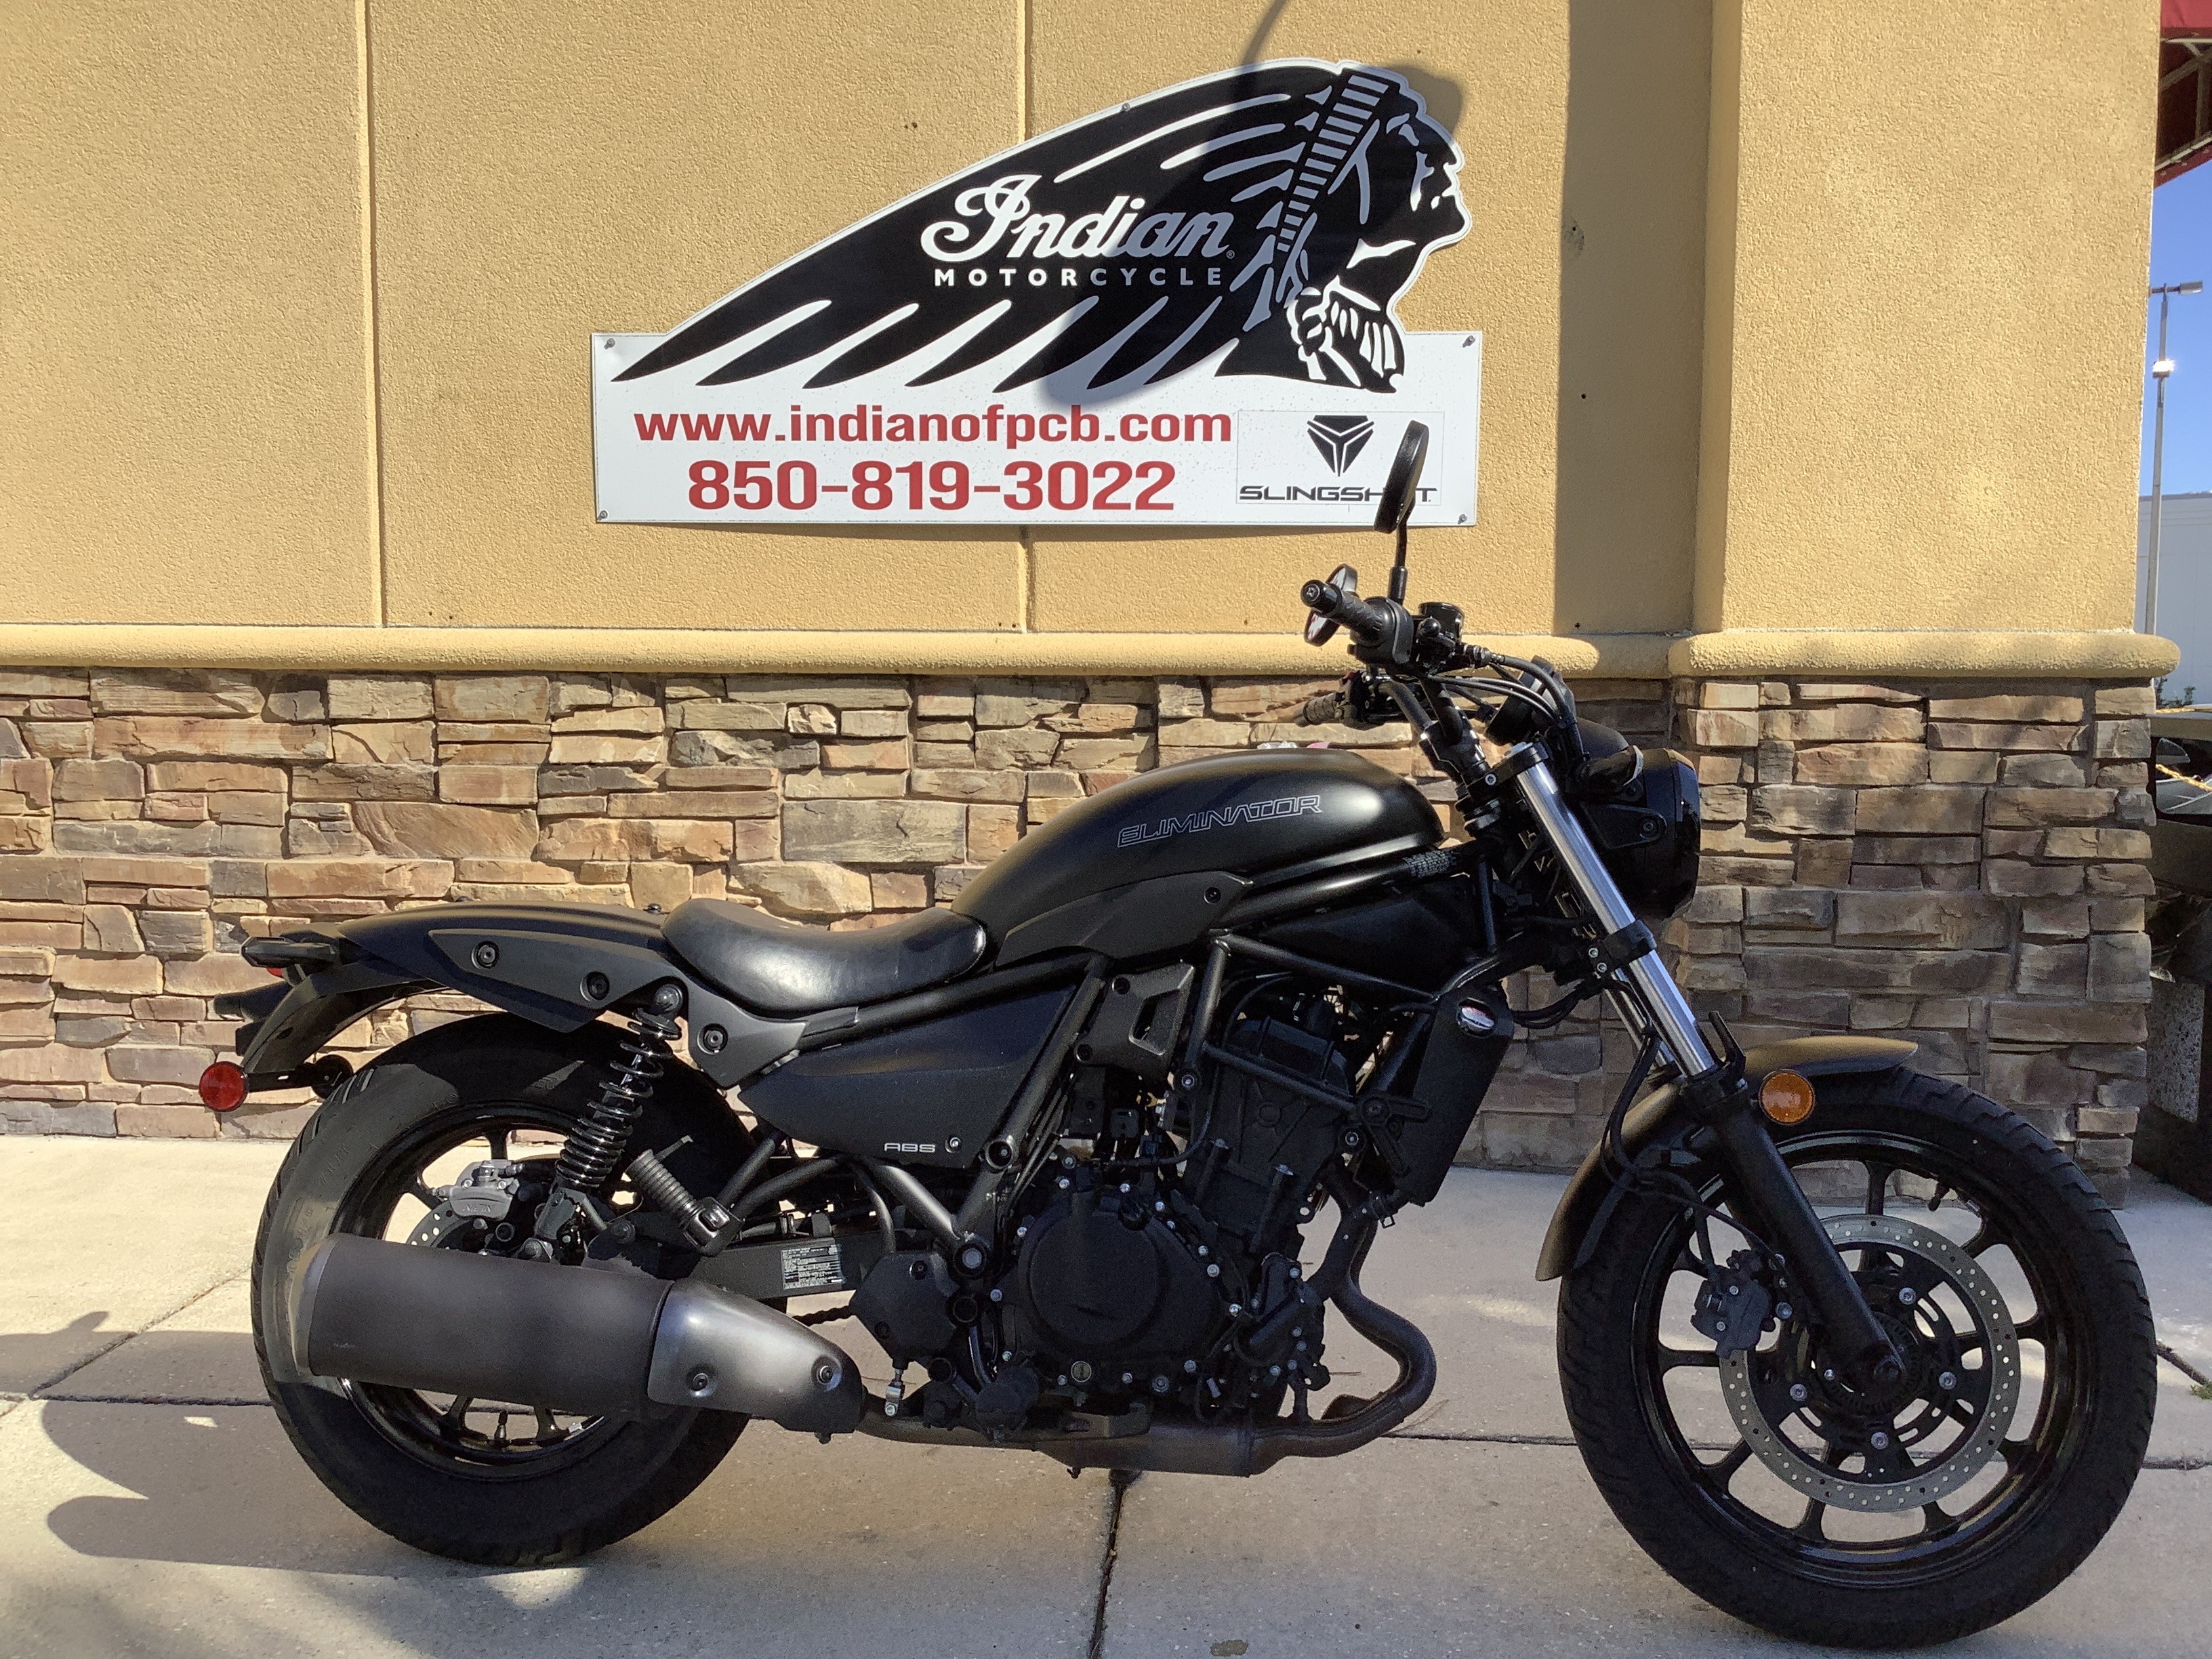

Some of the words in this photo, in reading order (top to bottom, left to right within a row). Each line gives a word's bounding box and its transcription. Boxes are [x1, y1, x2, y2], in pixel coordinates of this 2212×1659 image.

[920, 174, 1234, 262] Indian
[935, 268, 1222, 287] MOTORCYCLE
[634, 404, 1231, 449] www.indianofpcb.com
[689, 459, 1175, 510] 850-819-3022
[1240, 485, 1437, 502] SLINGSHT
[1118, 794, 1322, 847] ELIMINATOR
[884, 1143, 936, 1153] ABS
